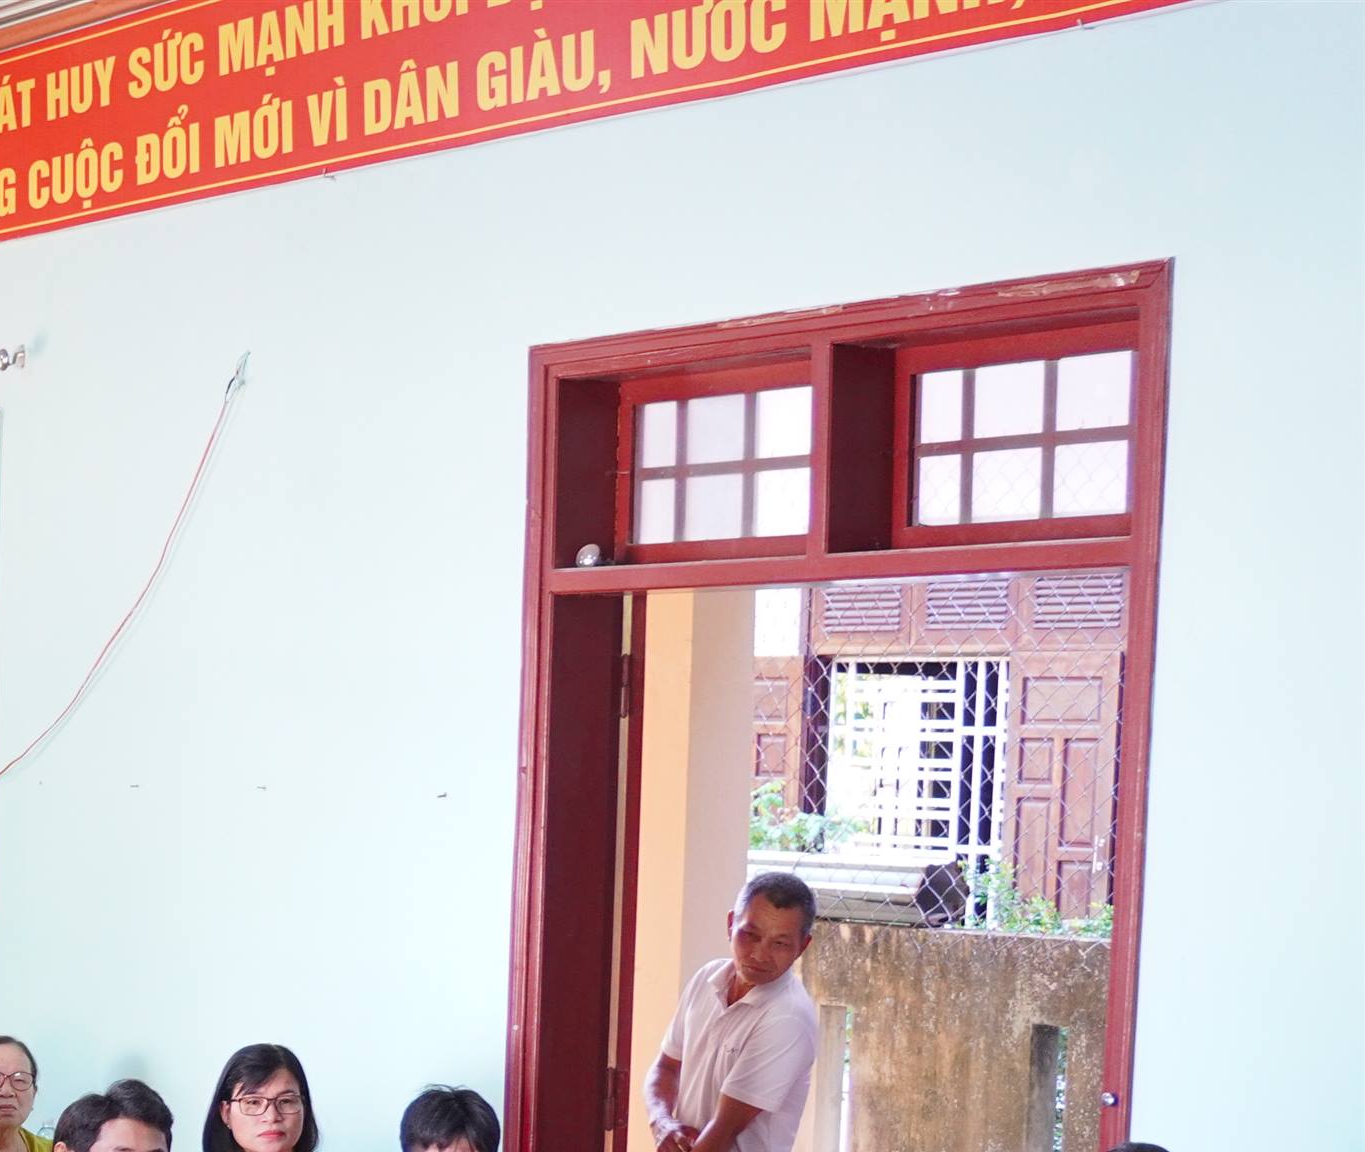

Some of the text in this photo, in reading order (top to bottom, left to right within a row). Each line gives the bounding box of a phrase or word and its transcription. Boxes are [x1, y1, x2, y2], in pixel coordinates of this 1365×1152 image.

[28, 137, 124, 210] CUỘC
[135, 104, 200, 186] ĐỔI
[214, 93, 294, 168] MỚI
[306, 76, 348, 147] VÌ
[363, 58, 460, 136] DÂN
[476, 27, 611, 112] GIÀU,
[46, 55, 116, 122] HUY
[128, 28, 205, 99] SỨC
[218, 0, 345, 77] MẠNH
